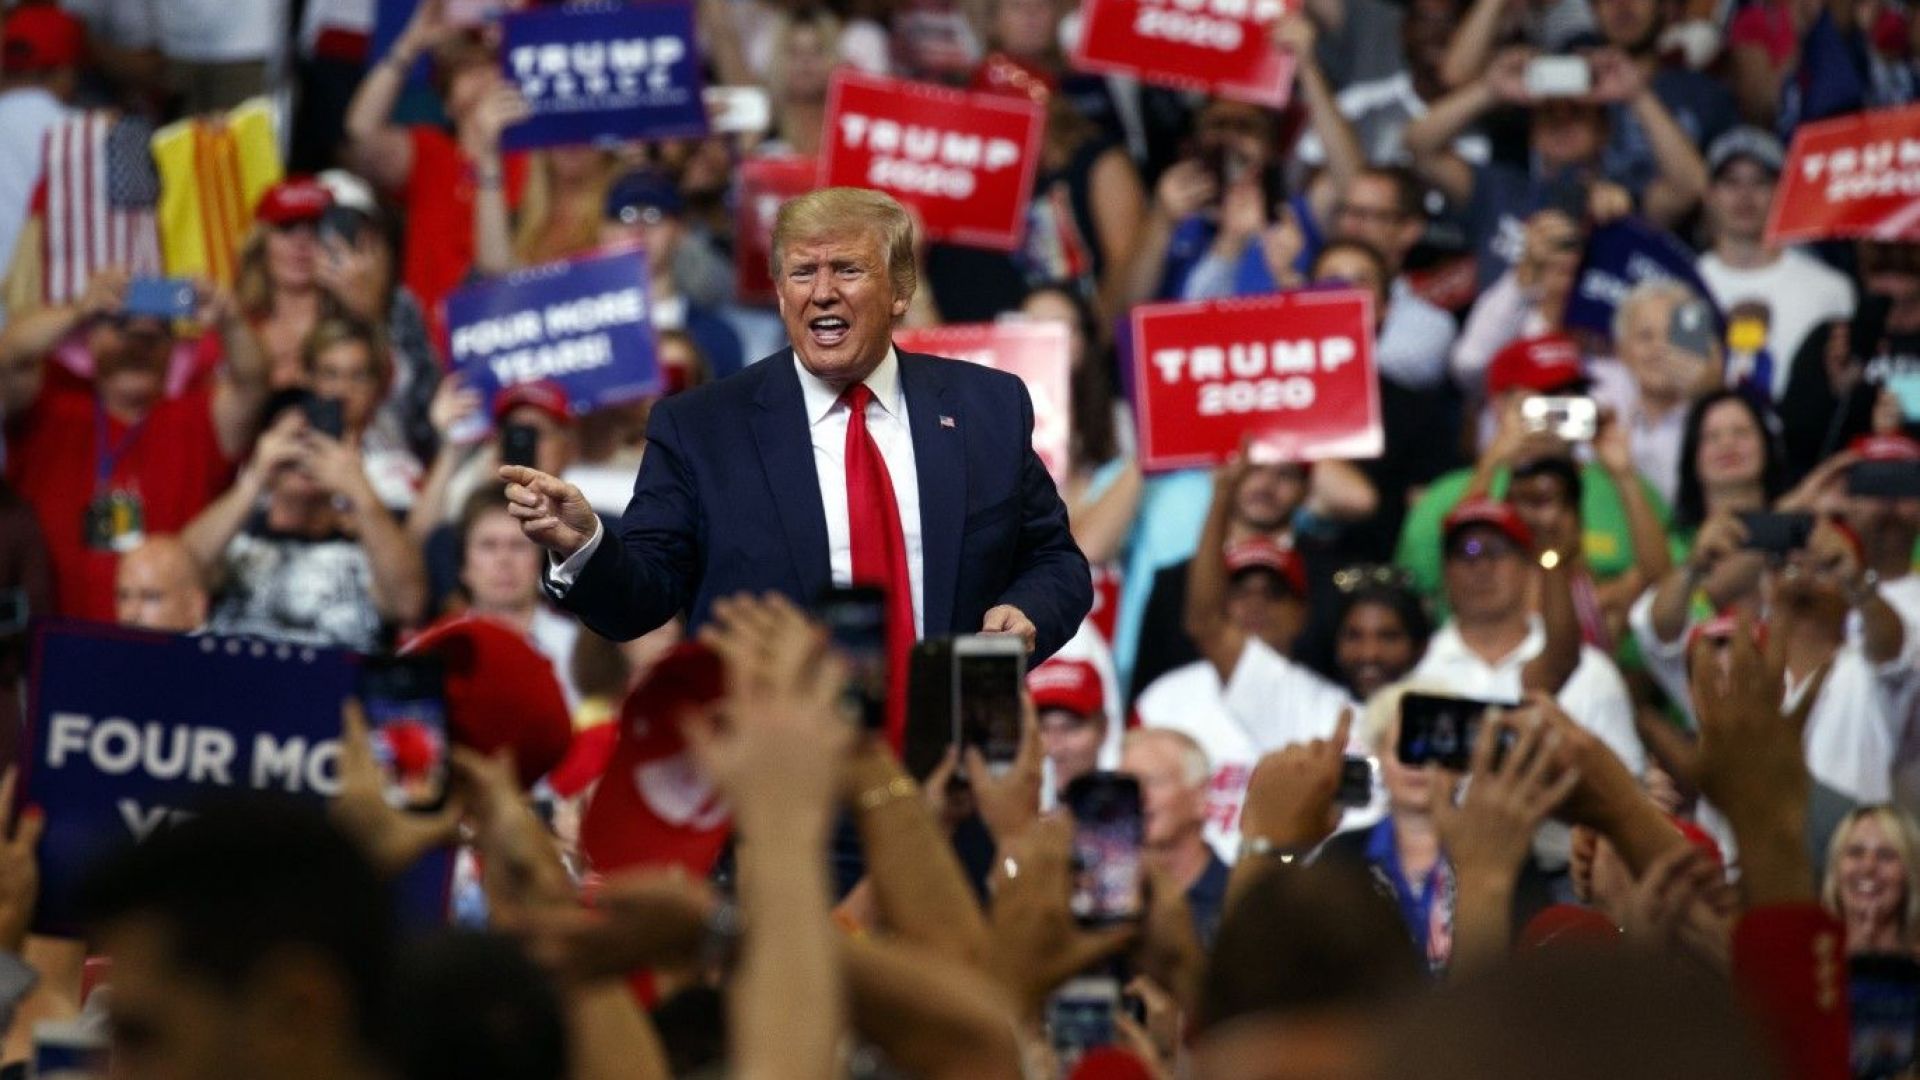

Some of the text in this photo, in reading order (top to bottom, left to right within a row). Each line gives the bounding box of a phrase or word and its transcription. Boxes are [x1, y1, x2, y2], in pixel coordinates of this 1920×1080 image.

[1133, 7, 1243, 51] 2020
[510, 35, 685, 79] TRUMP
[840, 112, 1020, 172] TRUMP
[1801, 137, 1920, 182] TRUM
[867, 154, 976, 199] 2020
[452, 287, 645, 360] FOUR MORE
[489, 331, 613, 387] YEARS!
[1152, 336, 1356, 384] TRUMP
[1198, 375, 1316, 417] 2020
[46, 712, 346, 796] FOUR MO
